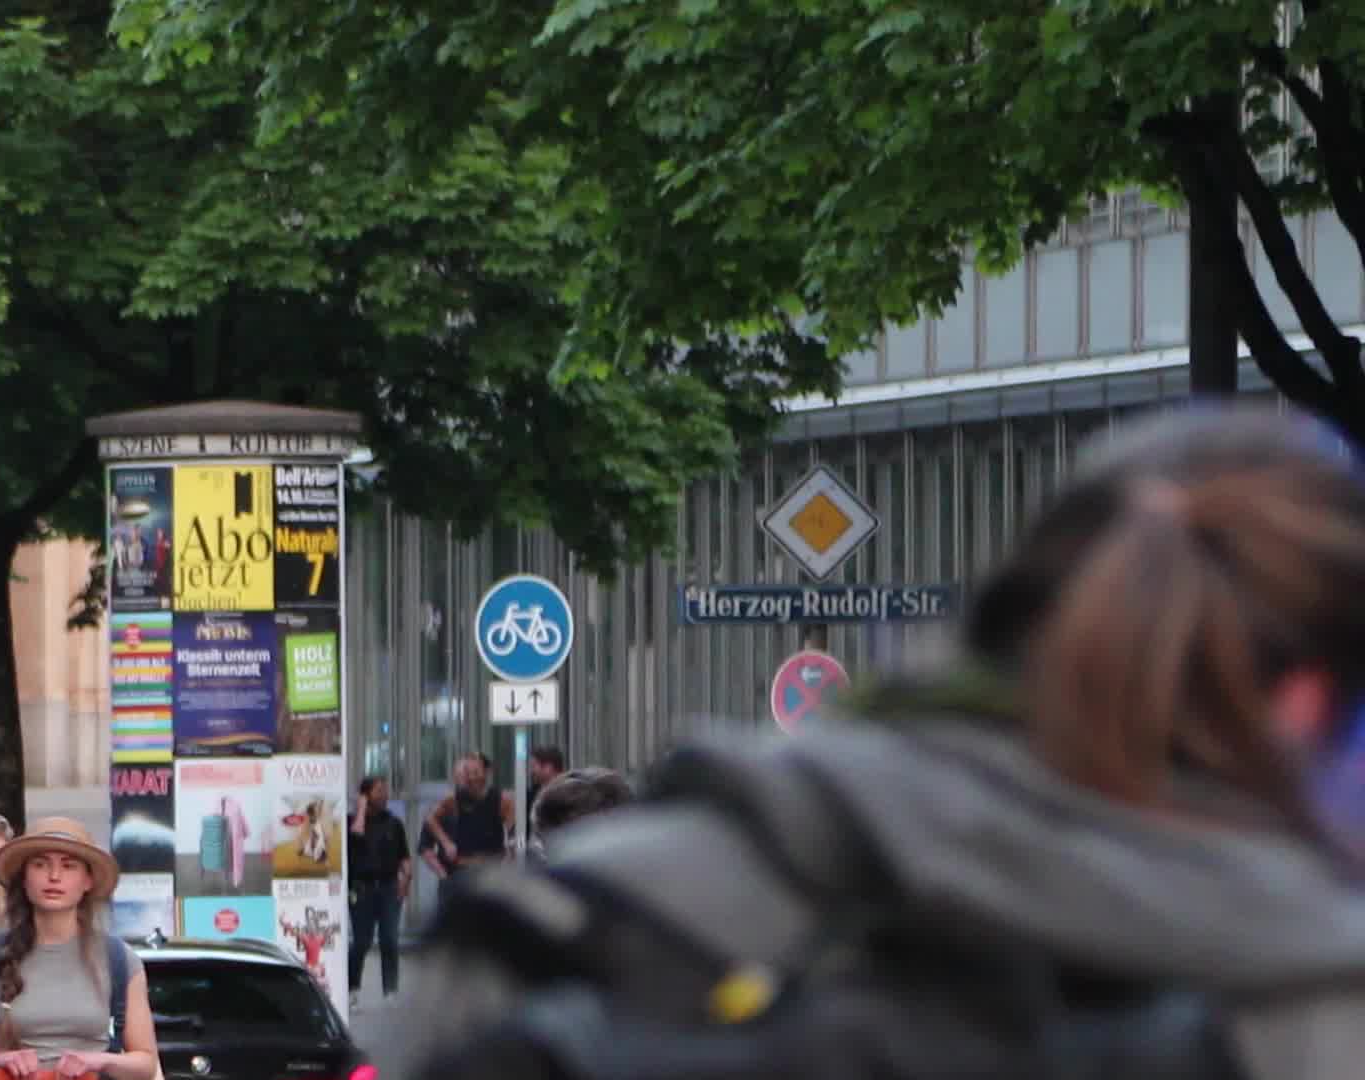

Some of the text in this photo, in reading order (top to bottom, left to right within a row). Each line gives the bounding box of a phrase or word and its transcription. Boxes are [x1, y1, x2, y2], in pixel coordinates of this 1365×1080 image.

[179, 515, 273, 563] Abo
[176, 557, 251, 597] jetzt
[306, 552, 325, 597] 7
[698, 587, 946, 621] Herzog-Rudolf-Str.
